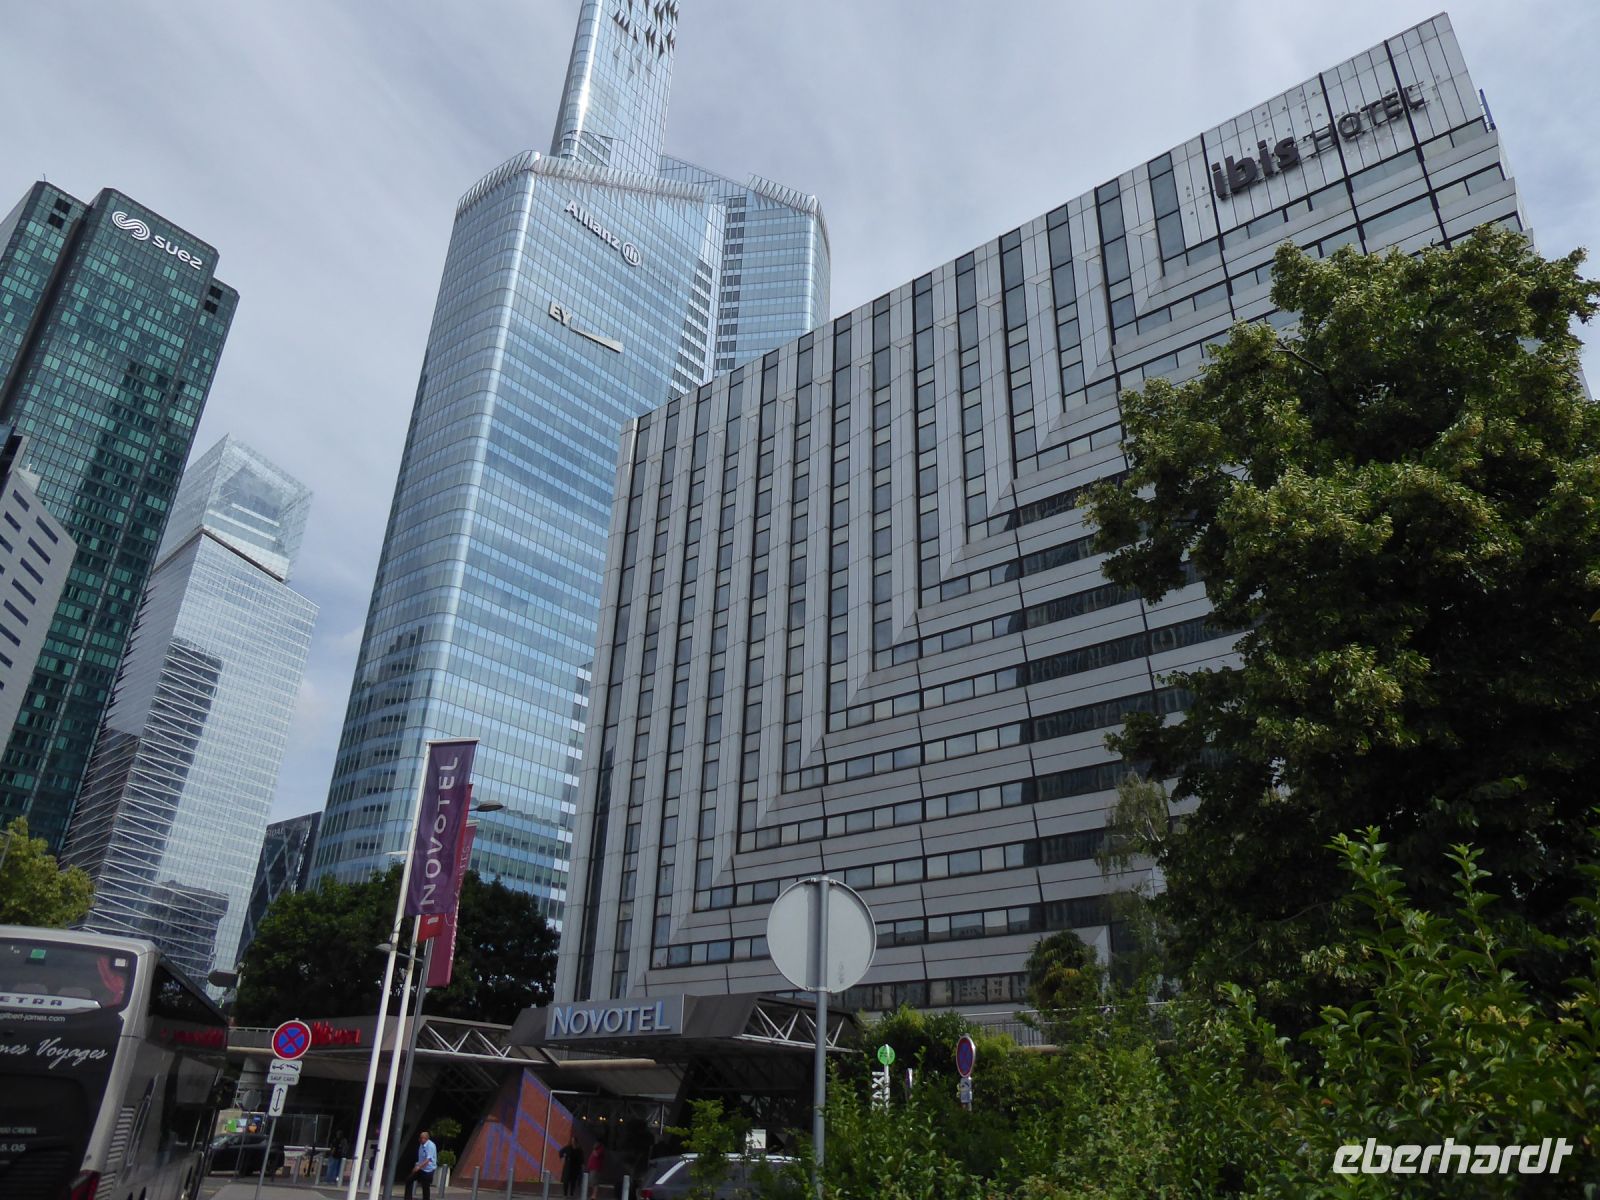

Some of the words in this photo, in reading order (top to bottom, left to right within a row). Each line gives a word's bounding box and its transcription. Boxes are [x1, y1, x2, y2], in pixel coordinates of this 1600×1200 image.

[1211, 138, 1299, 200] ibis
[1308, 83, 1427, 155] HOTEL
[564, 199, 621, 251] Allianz
[152, 234, 203, 270] suez
[549, 301, 572, 326] EY
[420, 756, 459, 906] NOVOTEL
[551, 1000, 671, 1035] NOVOTEL
[36, 1037, 108, 1069] Voyages
